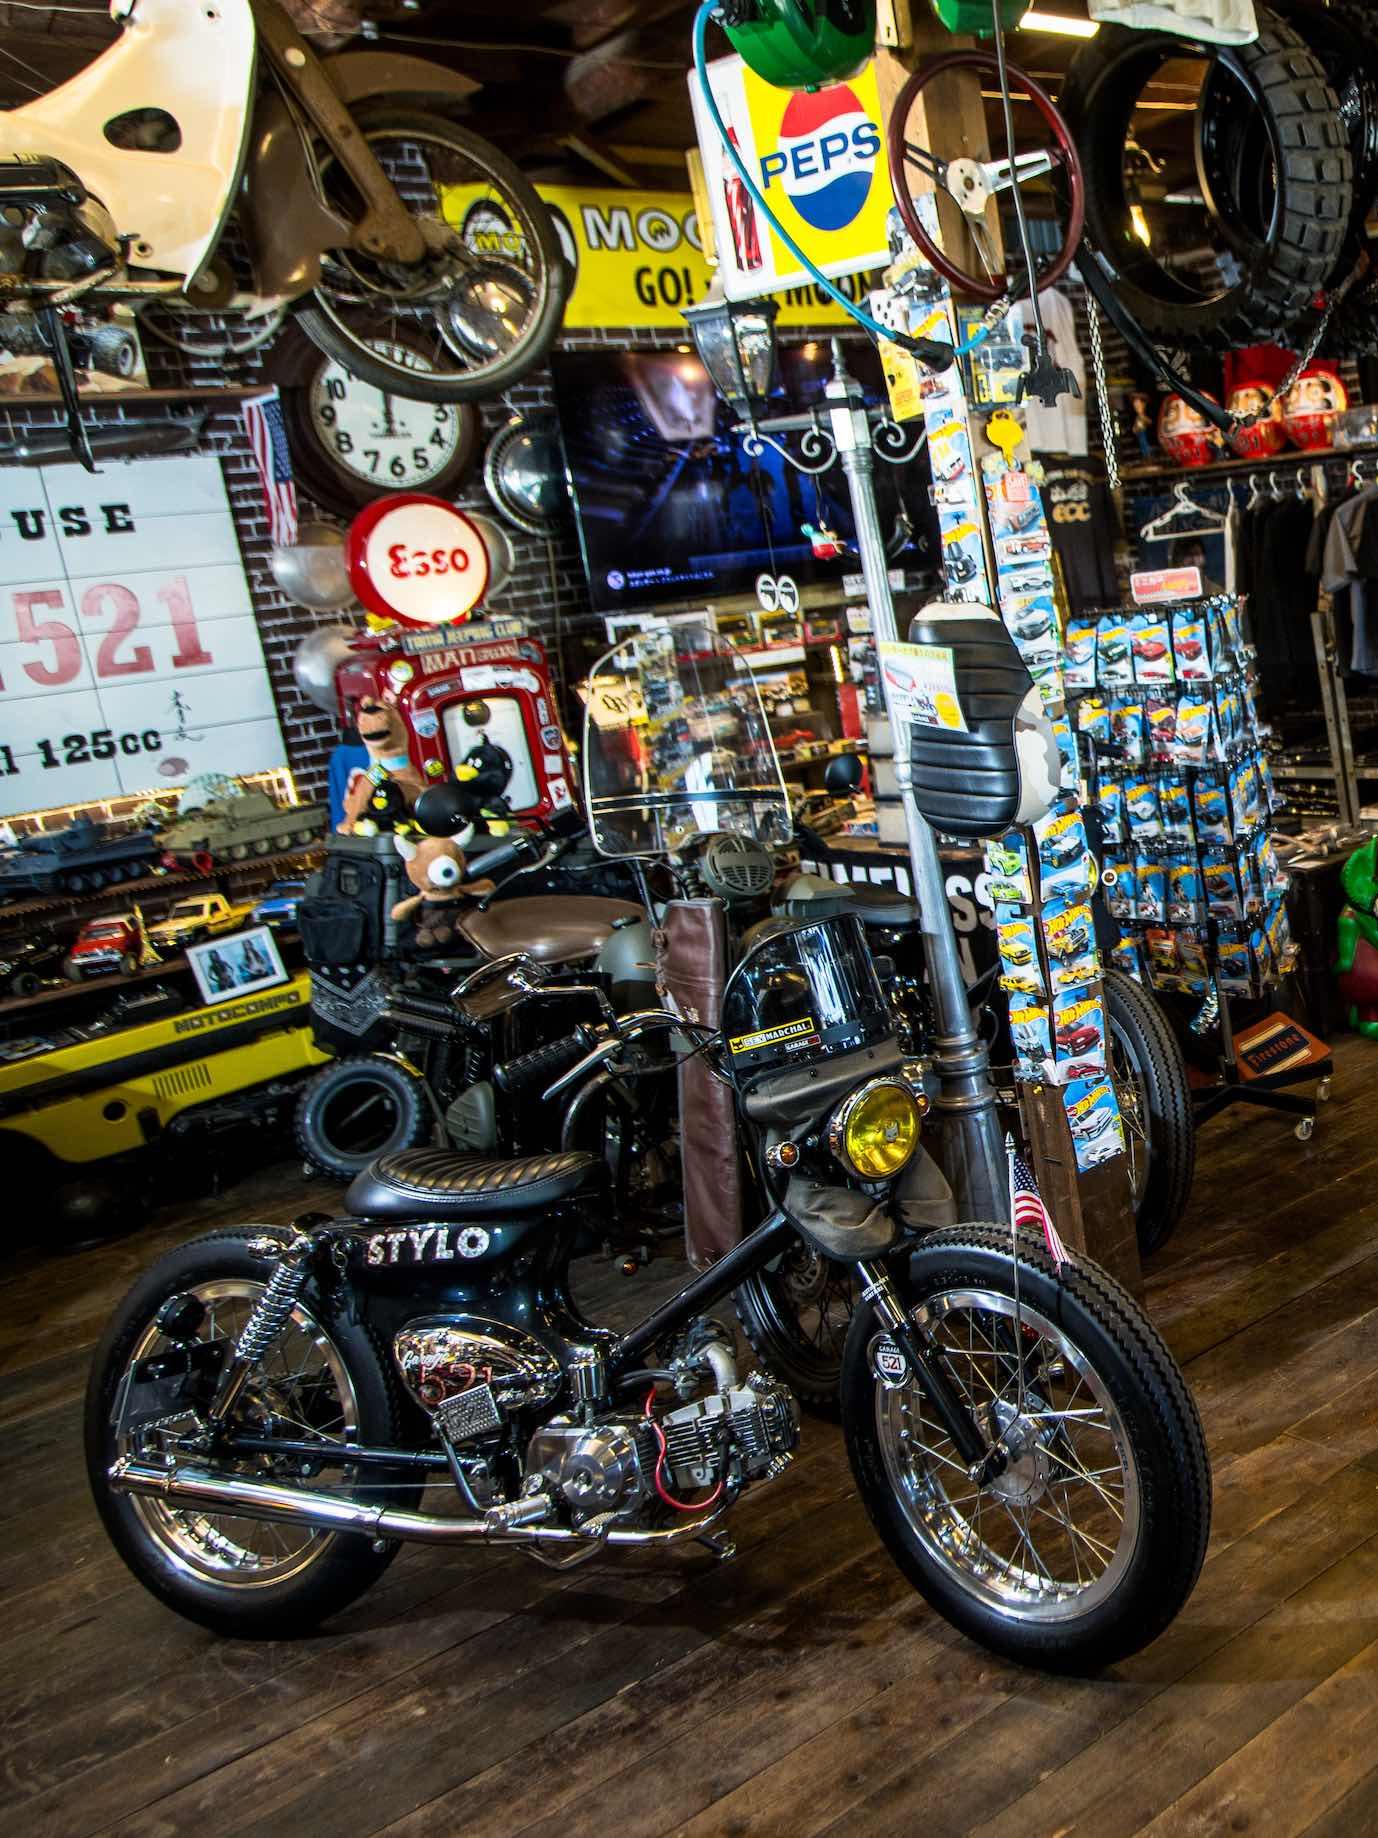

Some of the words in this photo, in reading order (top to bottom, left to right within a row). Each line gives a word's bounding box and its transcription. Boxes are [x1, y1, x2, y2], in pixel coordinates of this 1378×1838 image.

[635, 265, 693, 306] GO!
[326, 379, 346, 400] 10
[320, 405, 336, 426] 9
[434, 403, 448, 422] 3
[335, 432, 353, 453] 8
[430, 428, 447, 448] 4
[363, 451, 380, 472] 7
[390, 456, 406, 476] 6
[412, 448, 429, 469] 5
[12, 576, 213, 686] 521
[37, 729, 162, 769] 125cc
[173, 990, 300, 1034] MOTOCOMPO
[367, 1226, 490, 1265] STYLO
[882, 1355, 901, 1370] 521
